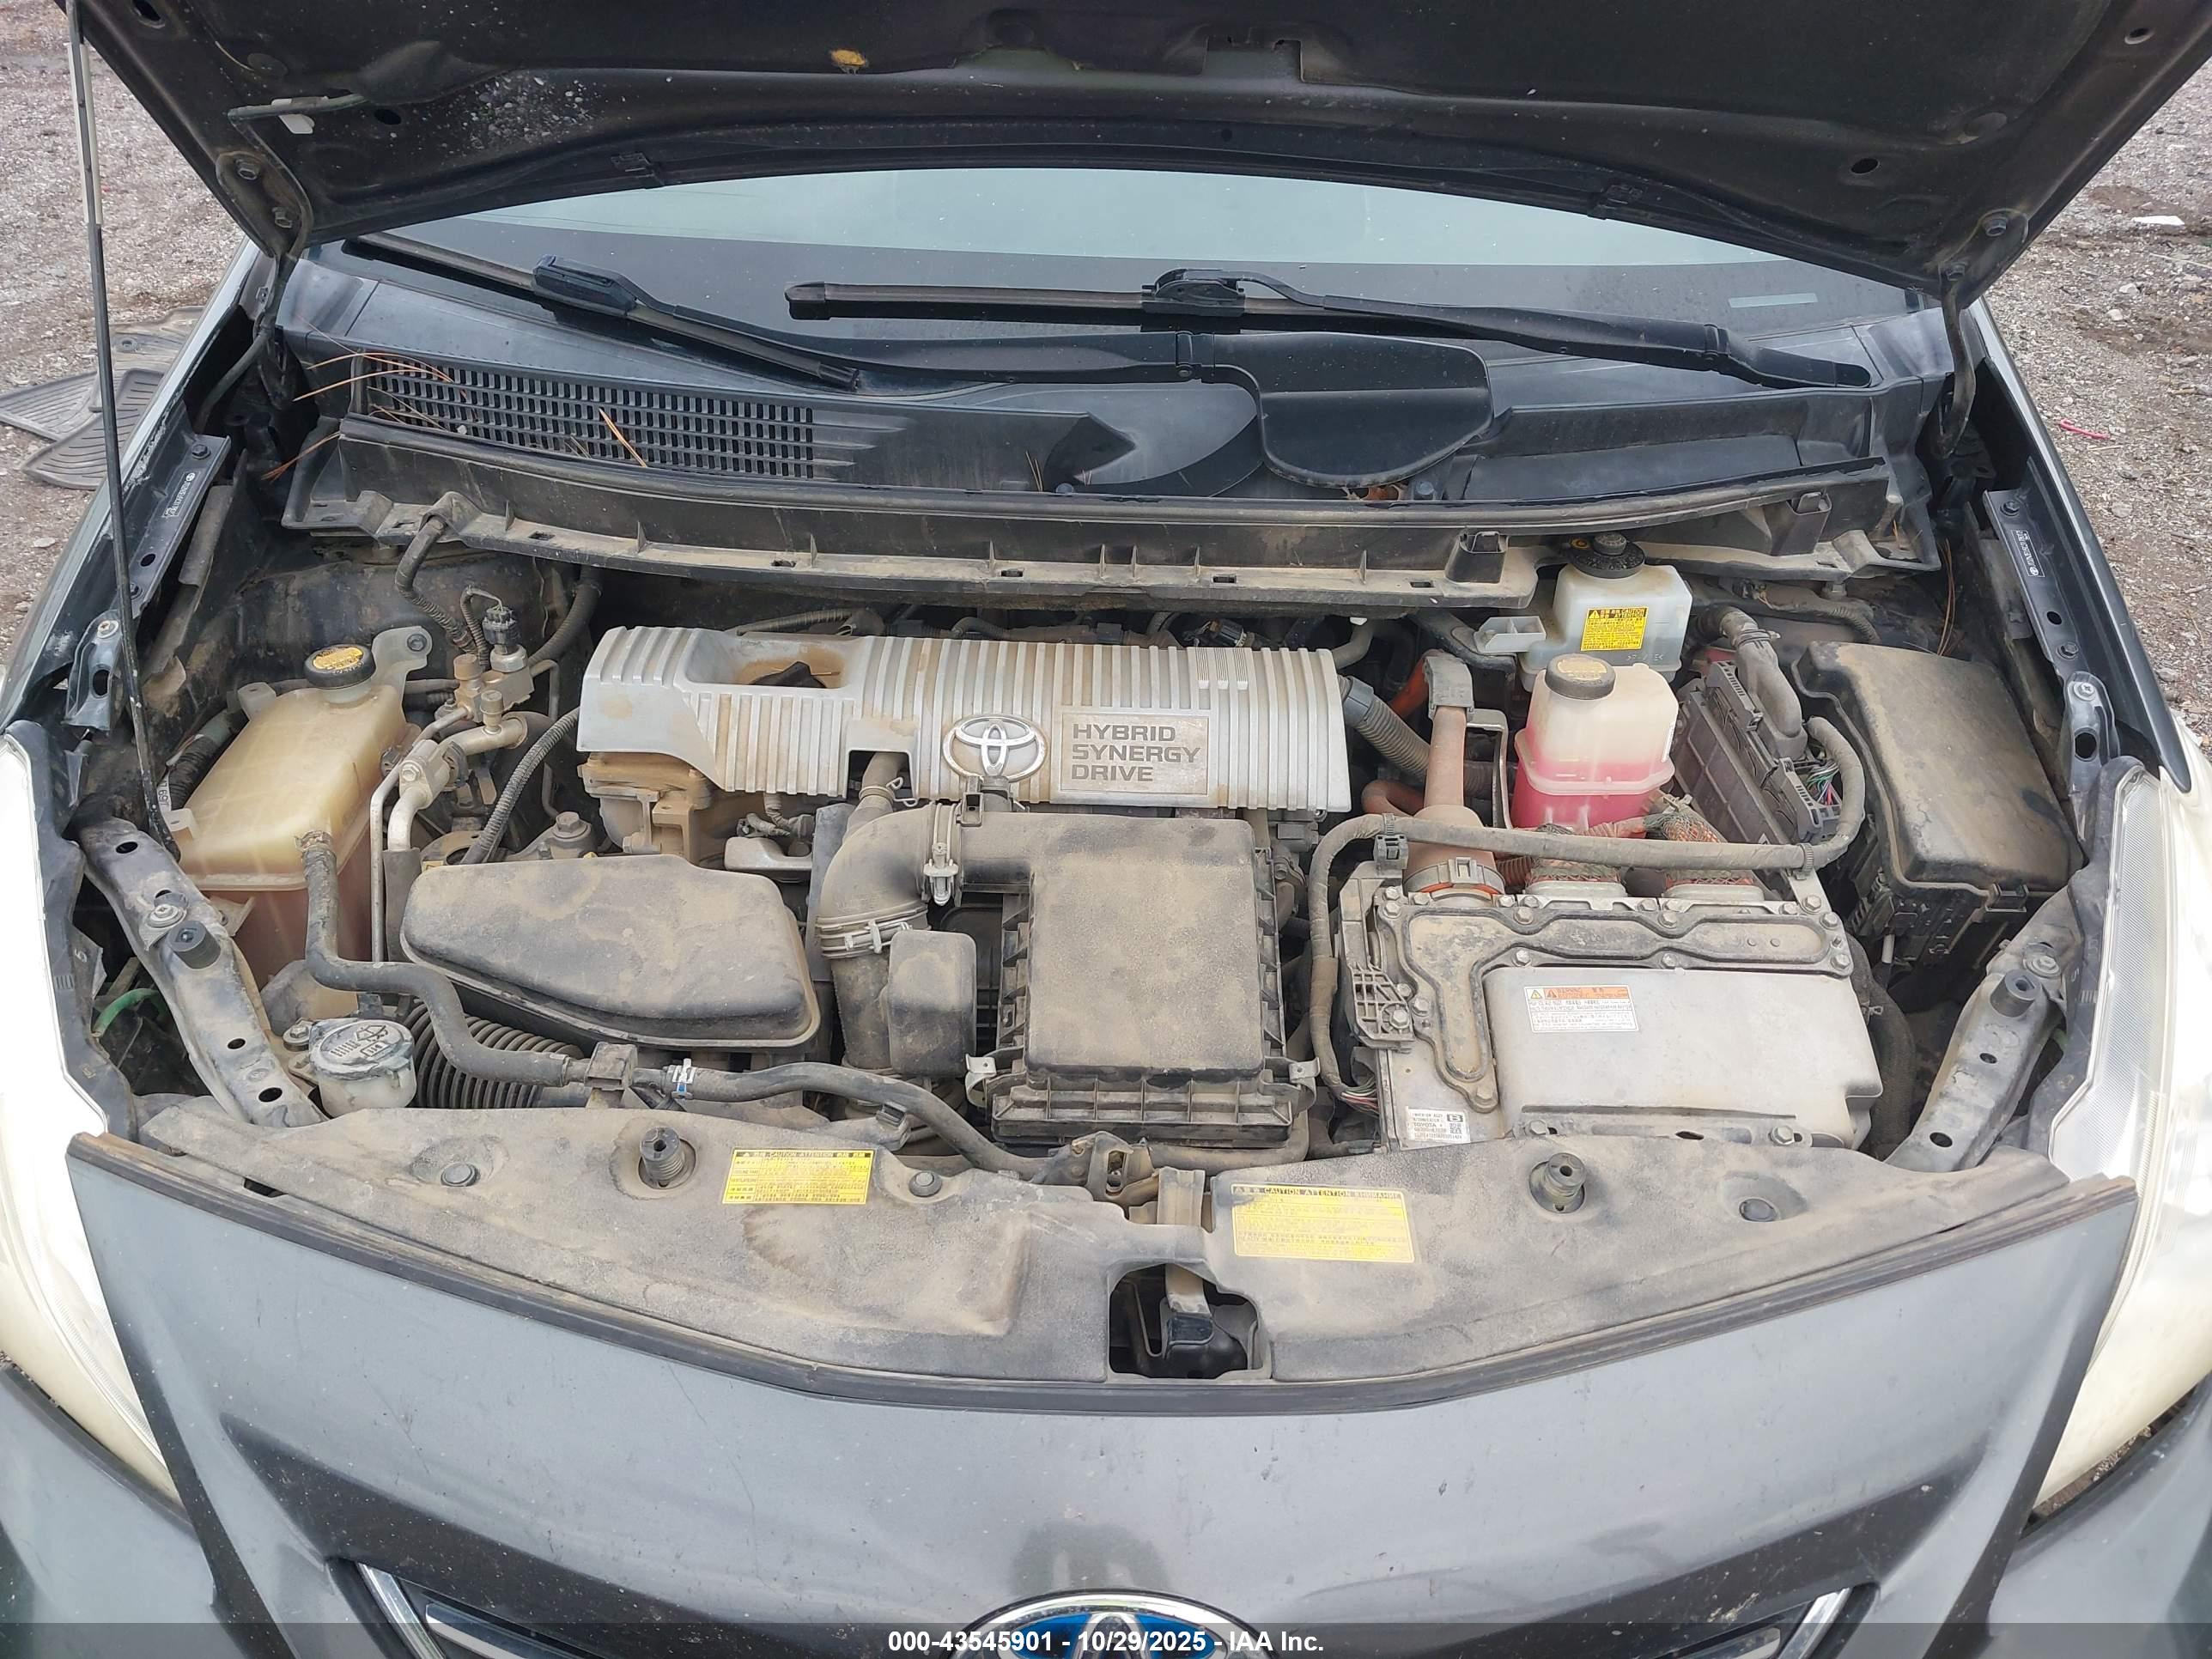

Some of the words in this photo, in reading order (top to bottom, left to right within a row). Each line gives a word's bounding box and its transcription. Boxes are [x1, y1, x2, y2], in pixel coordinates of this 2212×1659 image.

[1073, 723, 1176, 742] HYBRID
[1072, 744, 1201, 763] SYNERGY
[1071, 764, 1154, 782] DRIVE
[1263, 1187, 1301, 1195] CAUTION
[1304, 1188, 1352, 1197] ATTENTION
